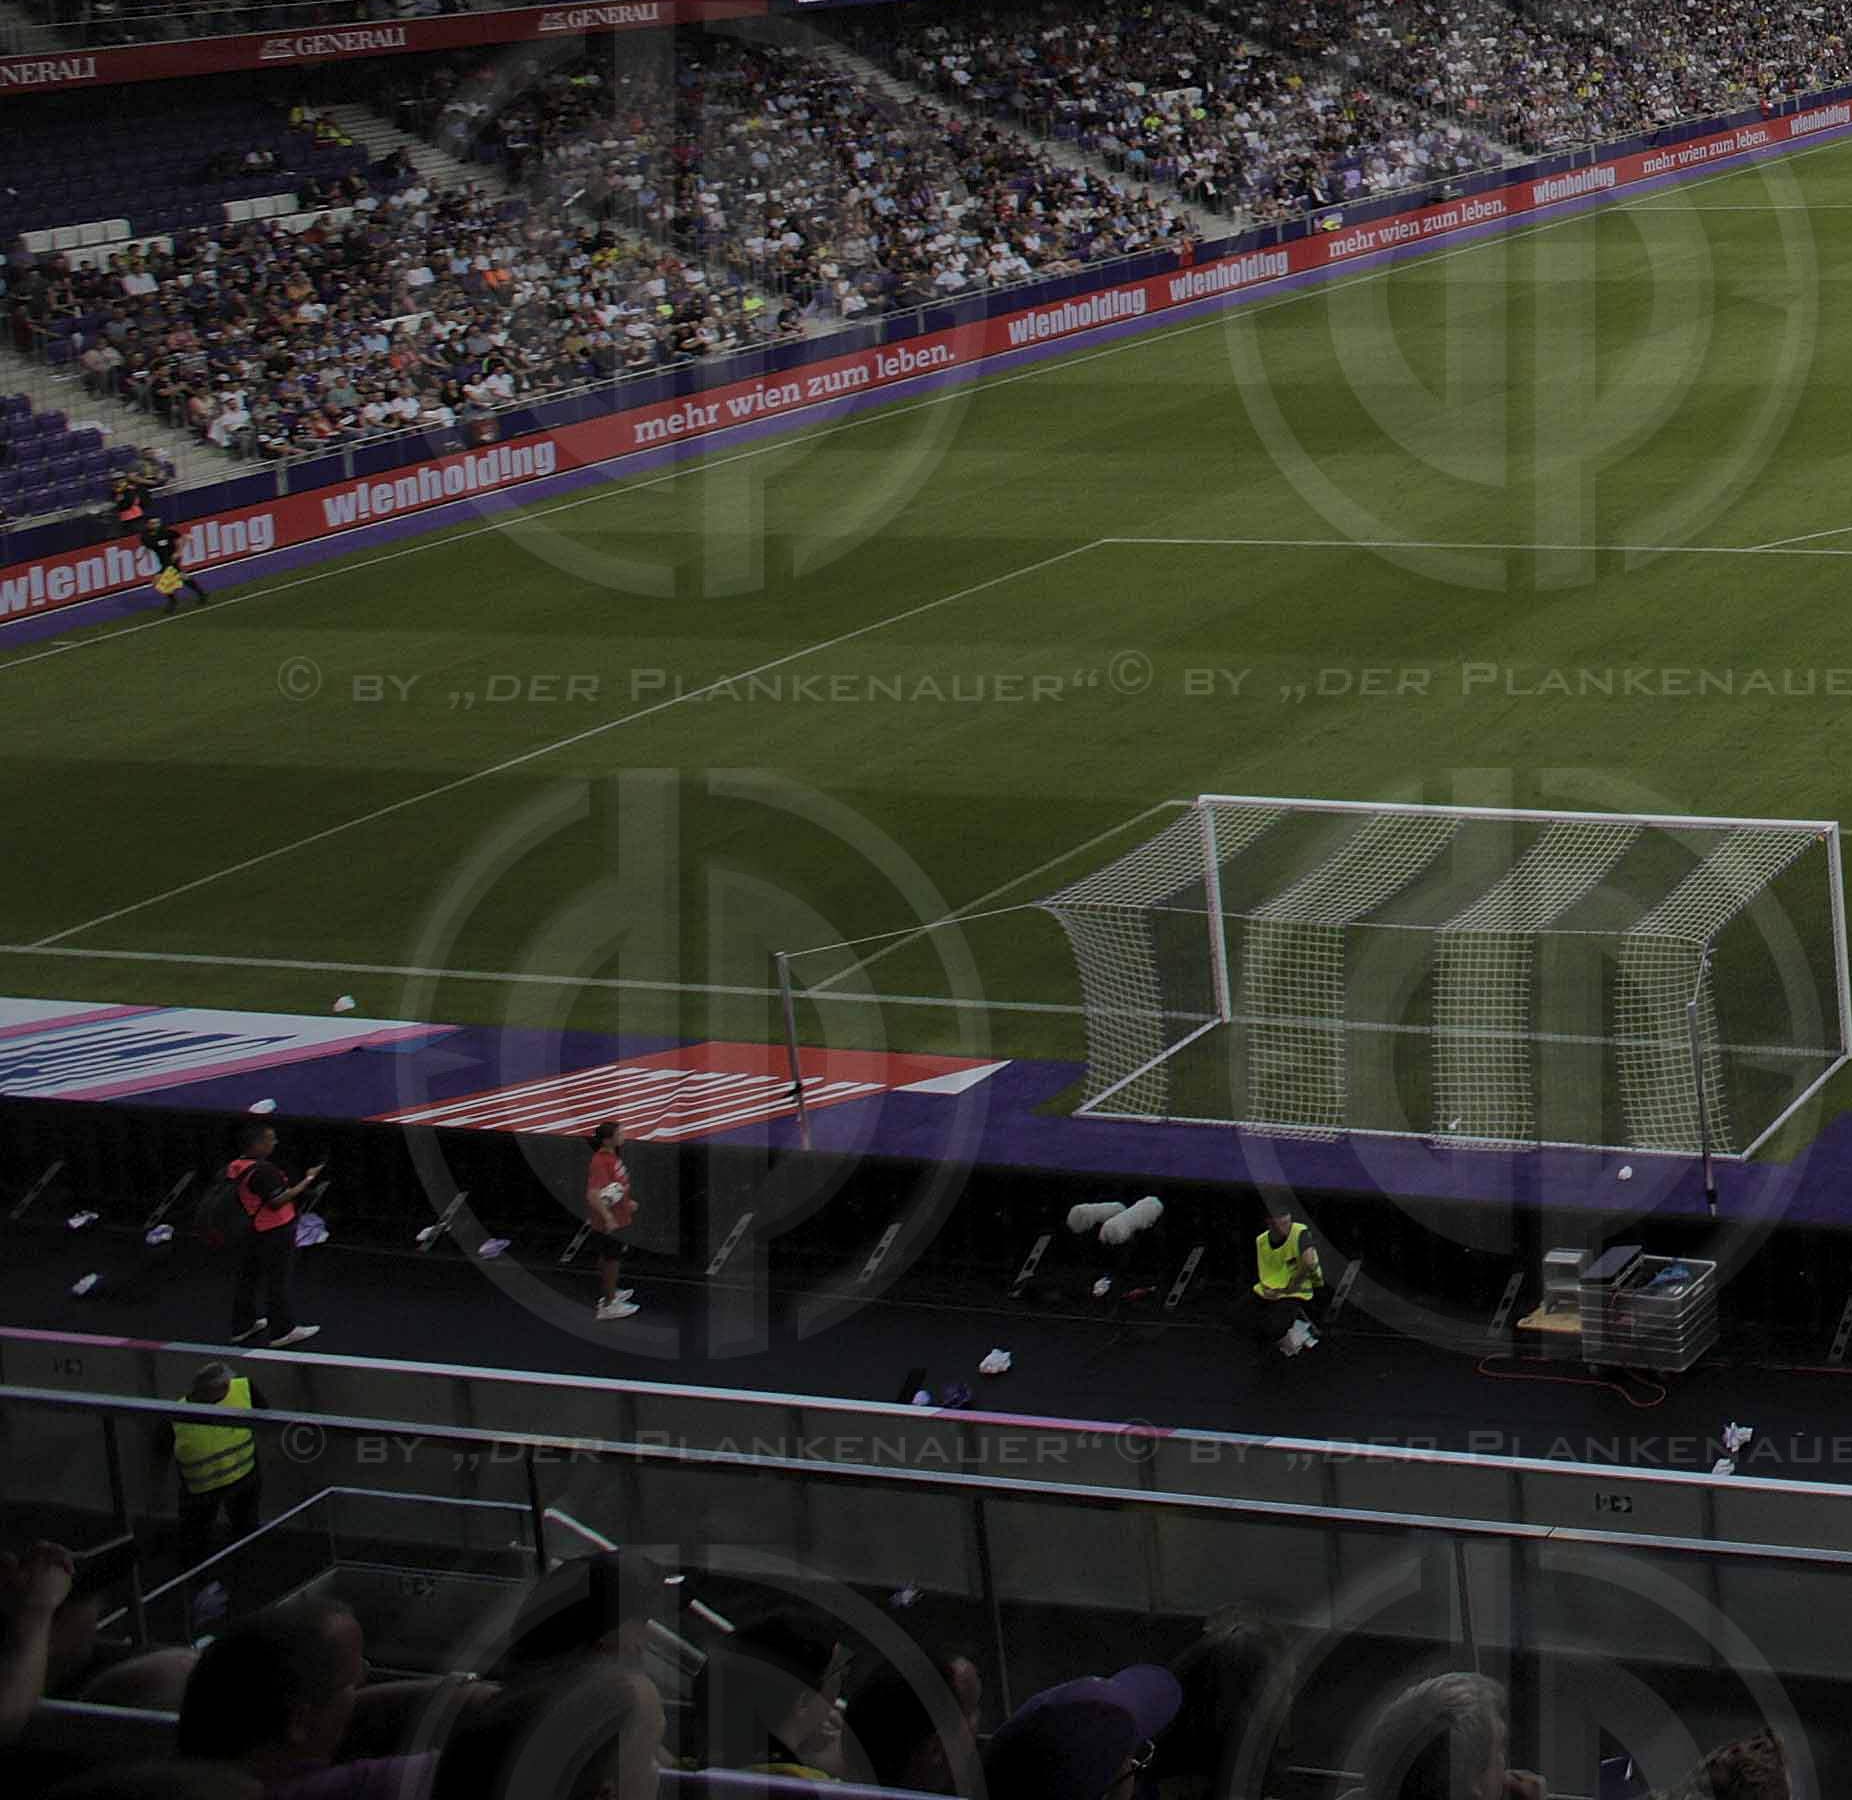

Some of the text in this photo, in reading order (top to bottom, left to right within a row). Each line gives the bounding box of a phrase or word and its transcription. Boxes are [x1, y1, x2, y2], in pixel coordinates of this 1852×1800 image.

[567, 3, 659, 29] GENERALI
[295, 27, 407, 57] GENERALI
[1643, 130, 1769, 174] mehr wien zum leben.
[1328, 198, 1507, 257] mehr wien zum leben.
[633, 346, 956, 444] mehr wien zum leben.
